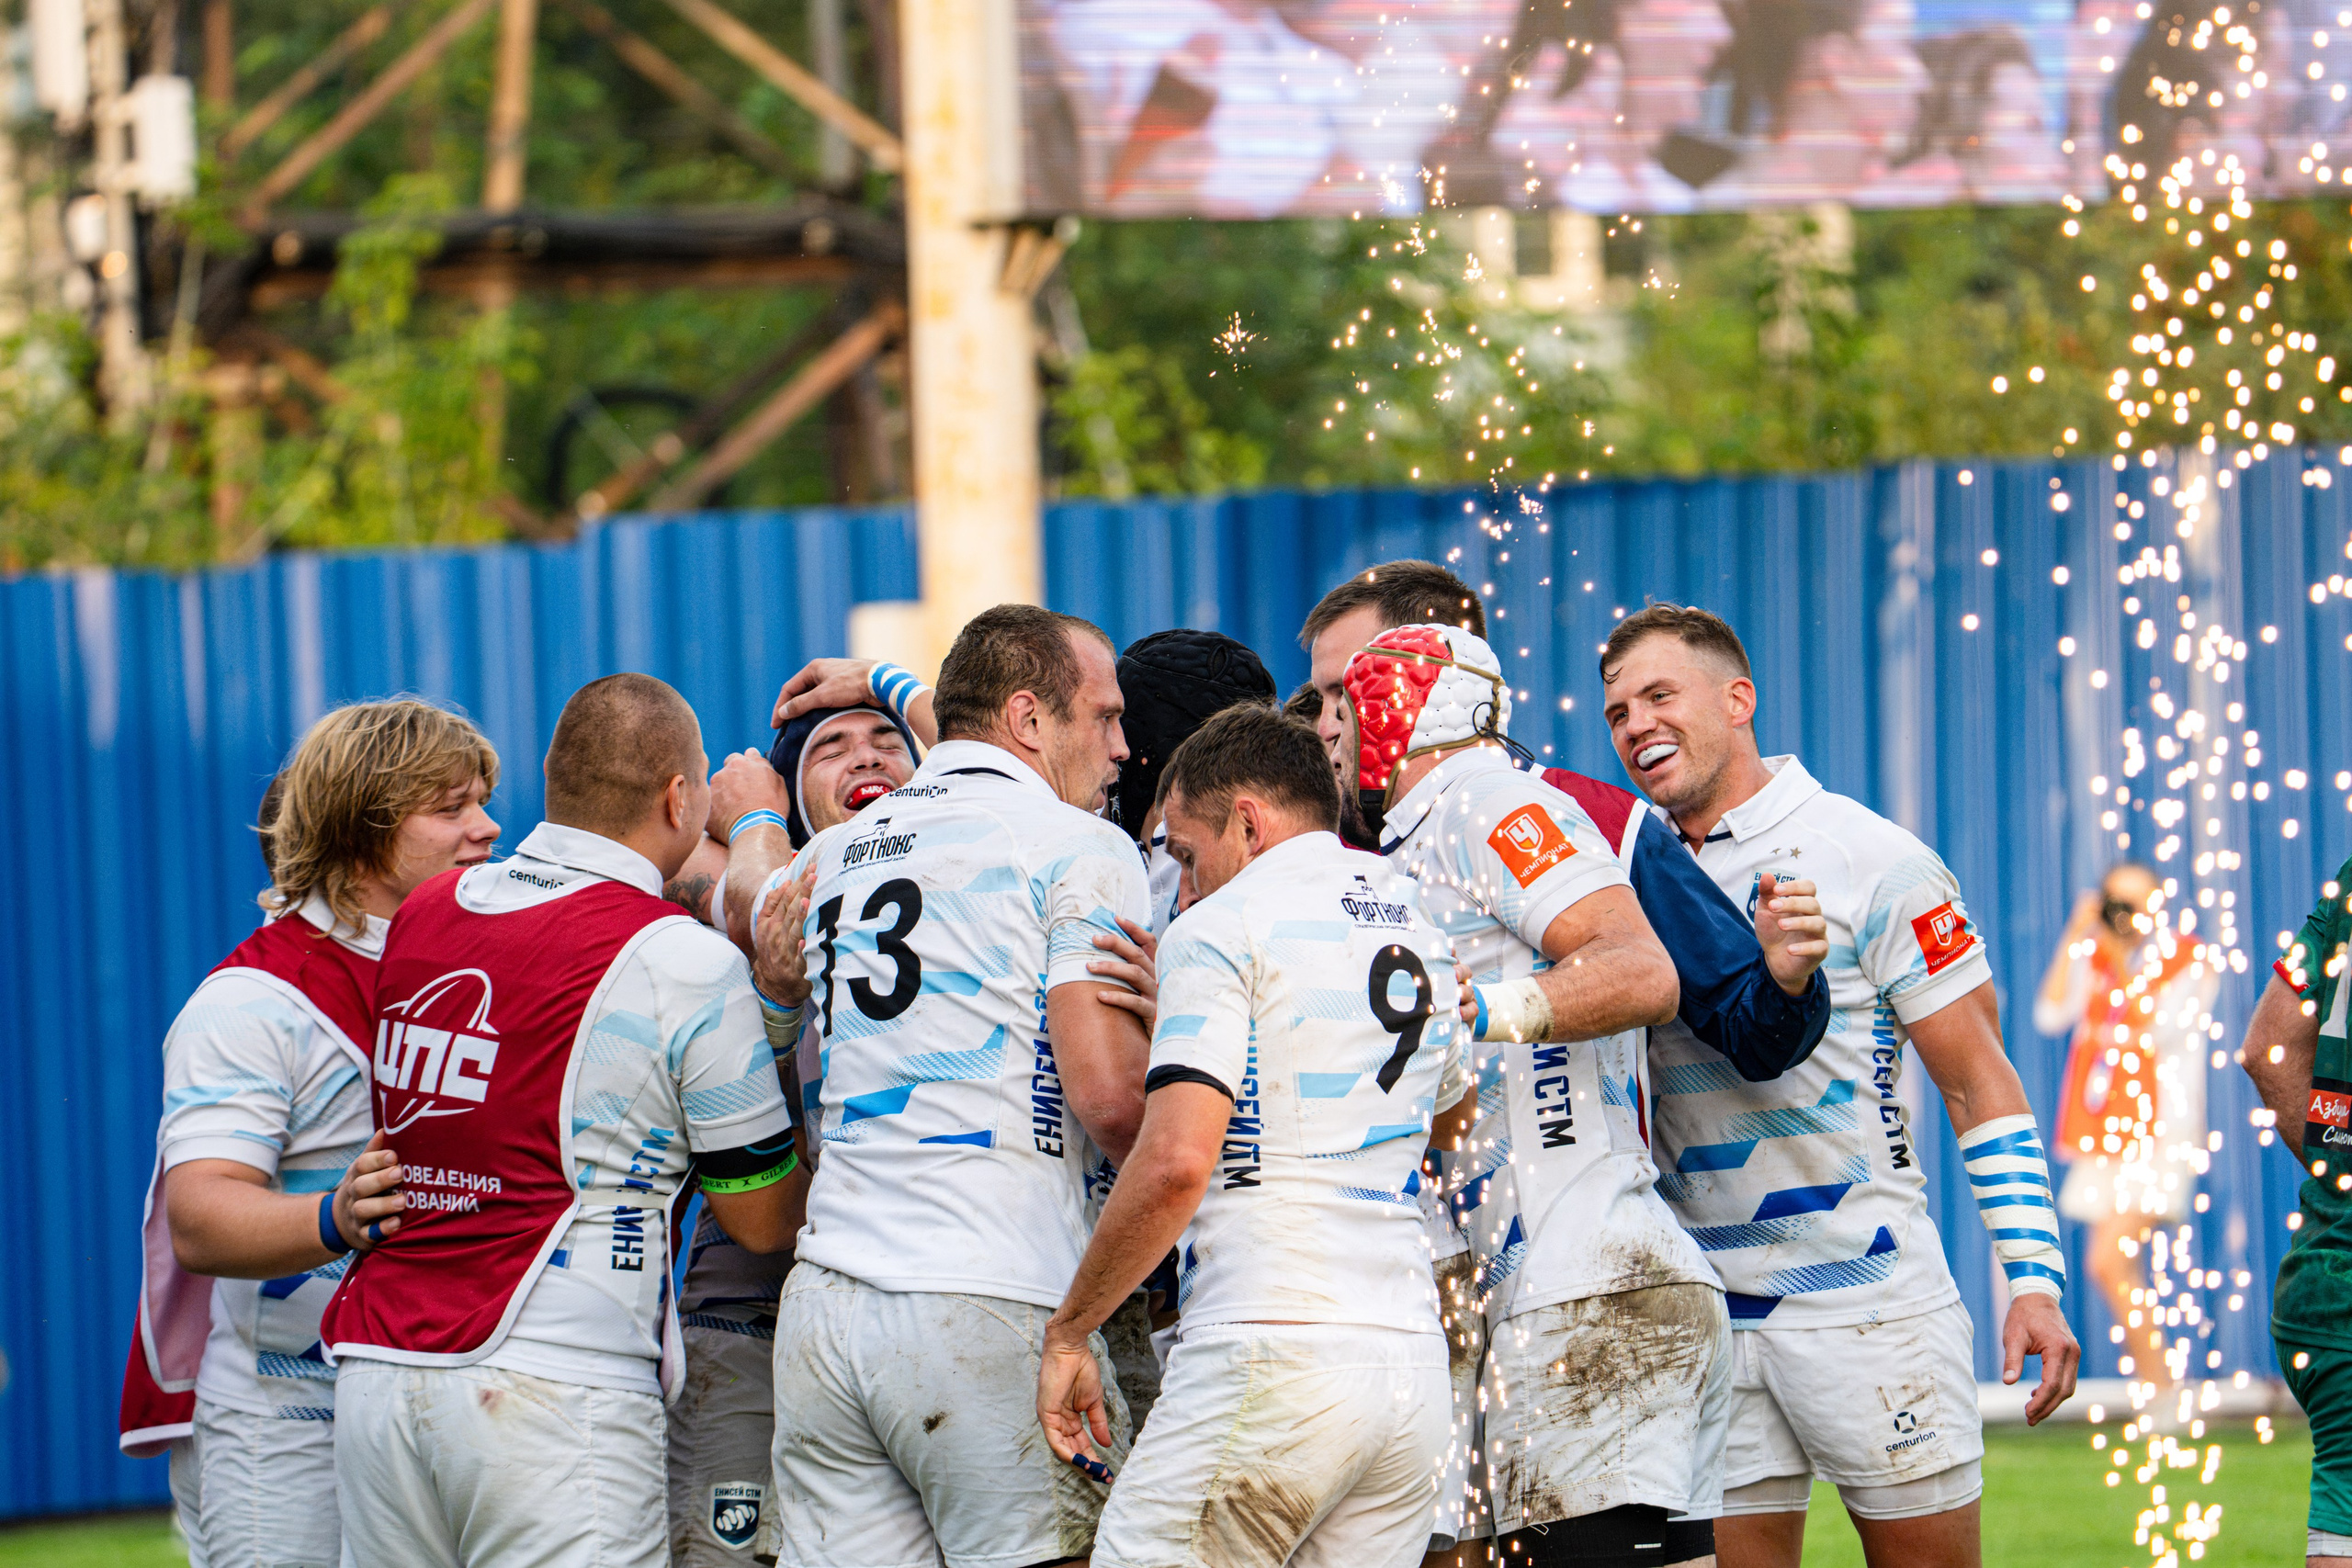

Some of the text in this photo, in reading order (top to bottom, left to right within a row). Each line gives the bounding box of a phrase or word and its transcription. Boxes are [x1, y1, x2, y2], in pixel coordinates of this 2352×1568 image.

[842, 833, 917, 867] ФОРТНОКС
[1519, 842, 1569, 878] ЧЕМПИОНАТ
[817, 878, 923, 1038] 13
[1931, 935, 1972, 967] ЧЕМПИОНАТ
[1369, 944, 1436, 1095] 9
[374, 1019, 501, 1103] ЦПС
[1534, 1075, 1577, 1149] СТМ
[401, 1164, 502, 1194] ОВЕДЕНИЯ
[715, 1487, 761, 1498] ЕНИСЕЙ СТМ
